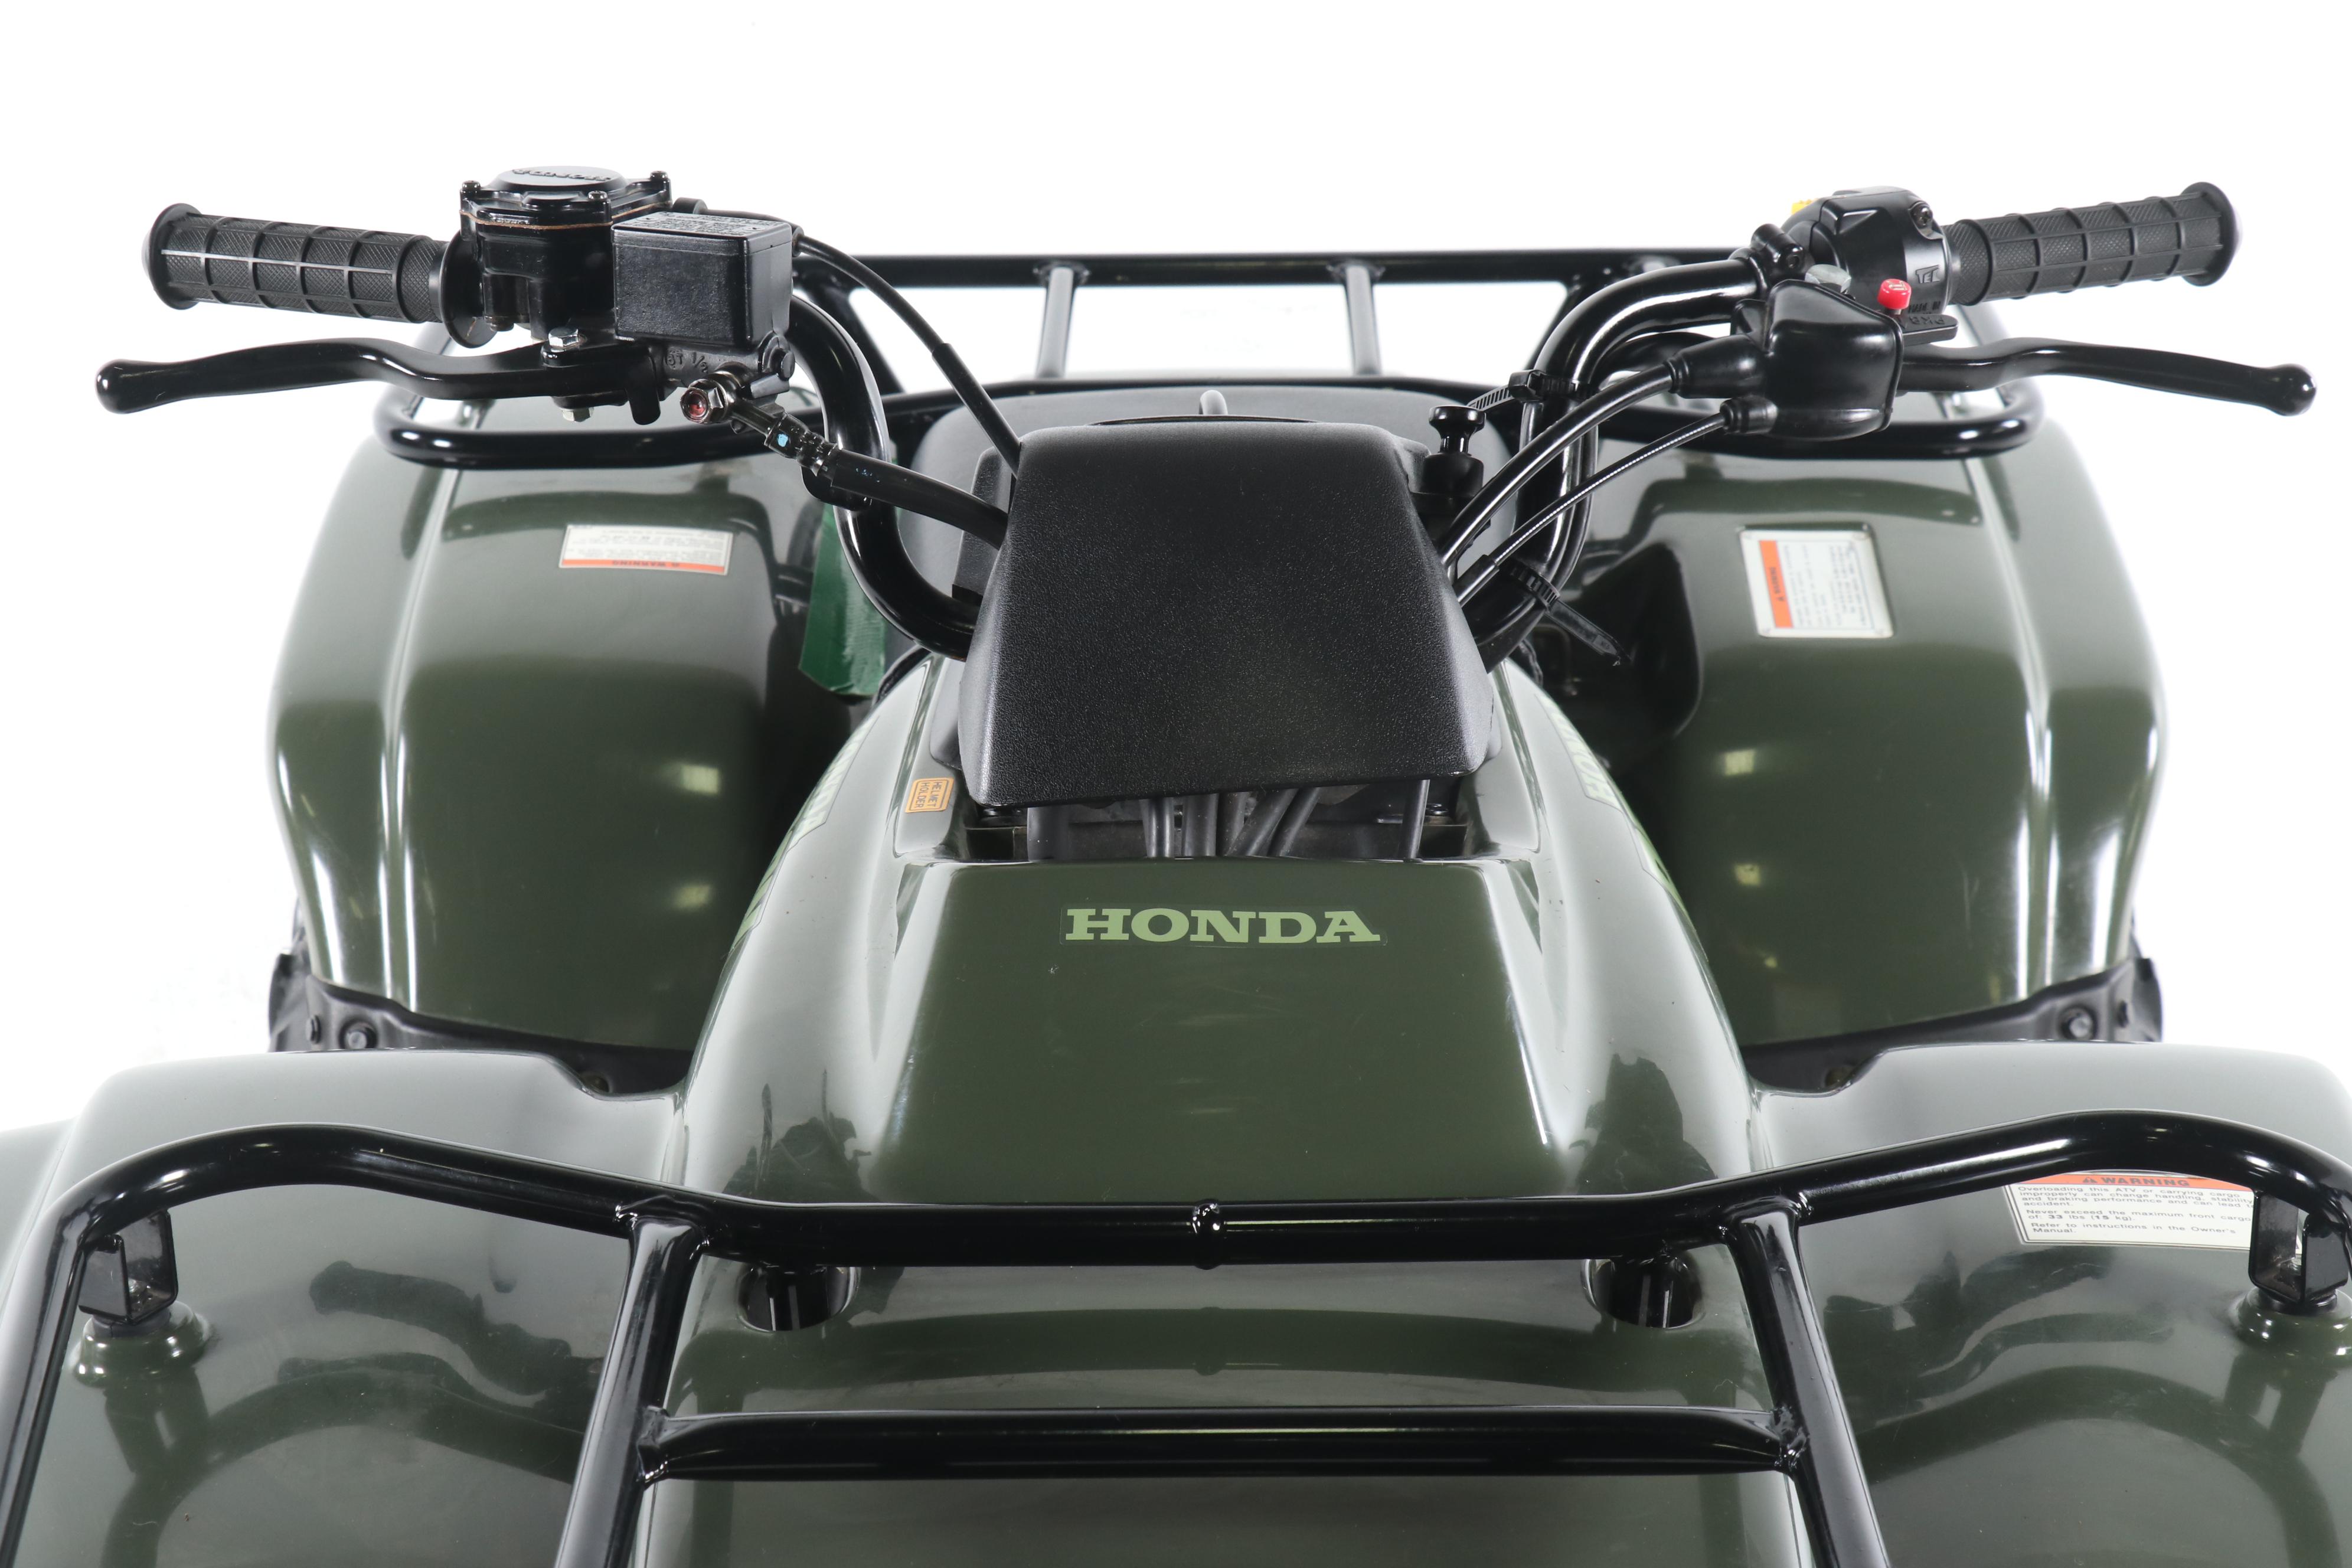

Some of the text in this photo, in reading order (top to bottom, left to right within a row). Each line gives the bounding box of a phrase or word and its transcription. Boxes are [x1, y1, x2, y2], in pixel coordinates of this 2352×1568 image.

[915, 782, 930, 808] HOLDER
[927, 782, 943, 806] HELMET
[1065, 908, 1381, 943] HONDA
[2101, 1177, 2190, 1186] WARNING
